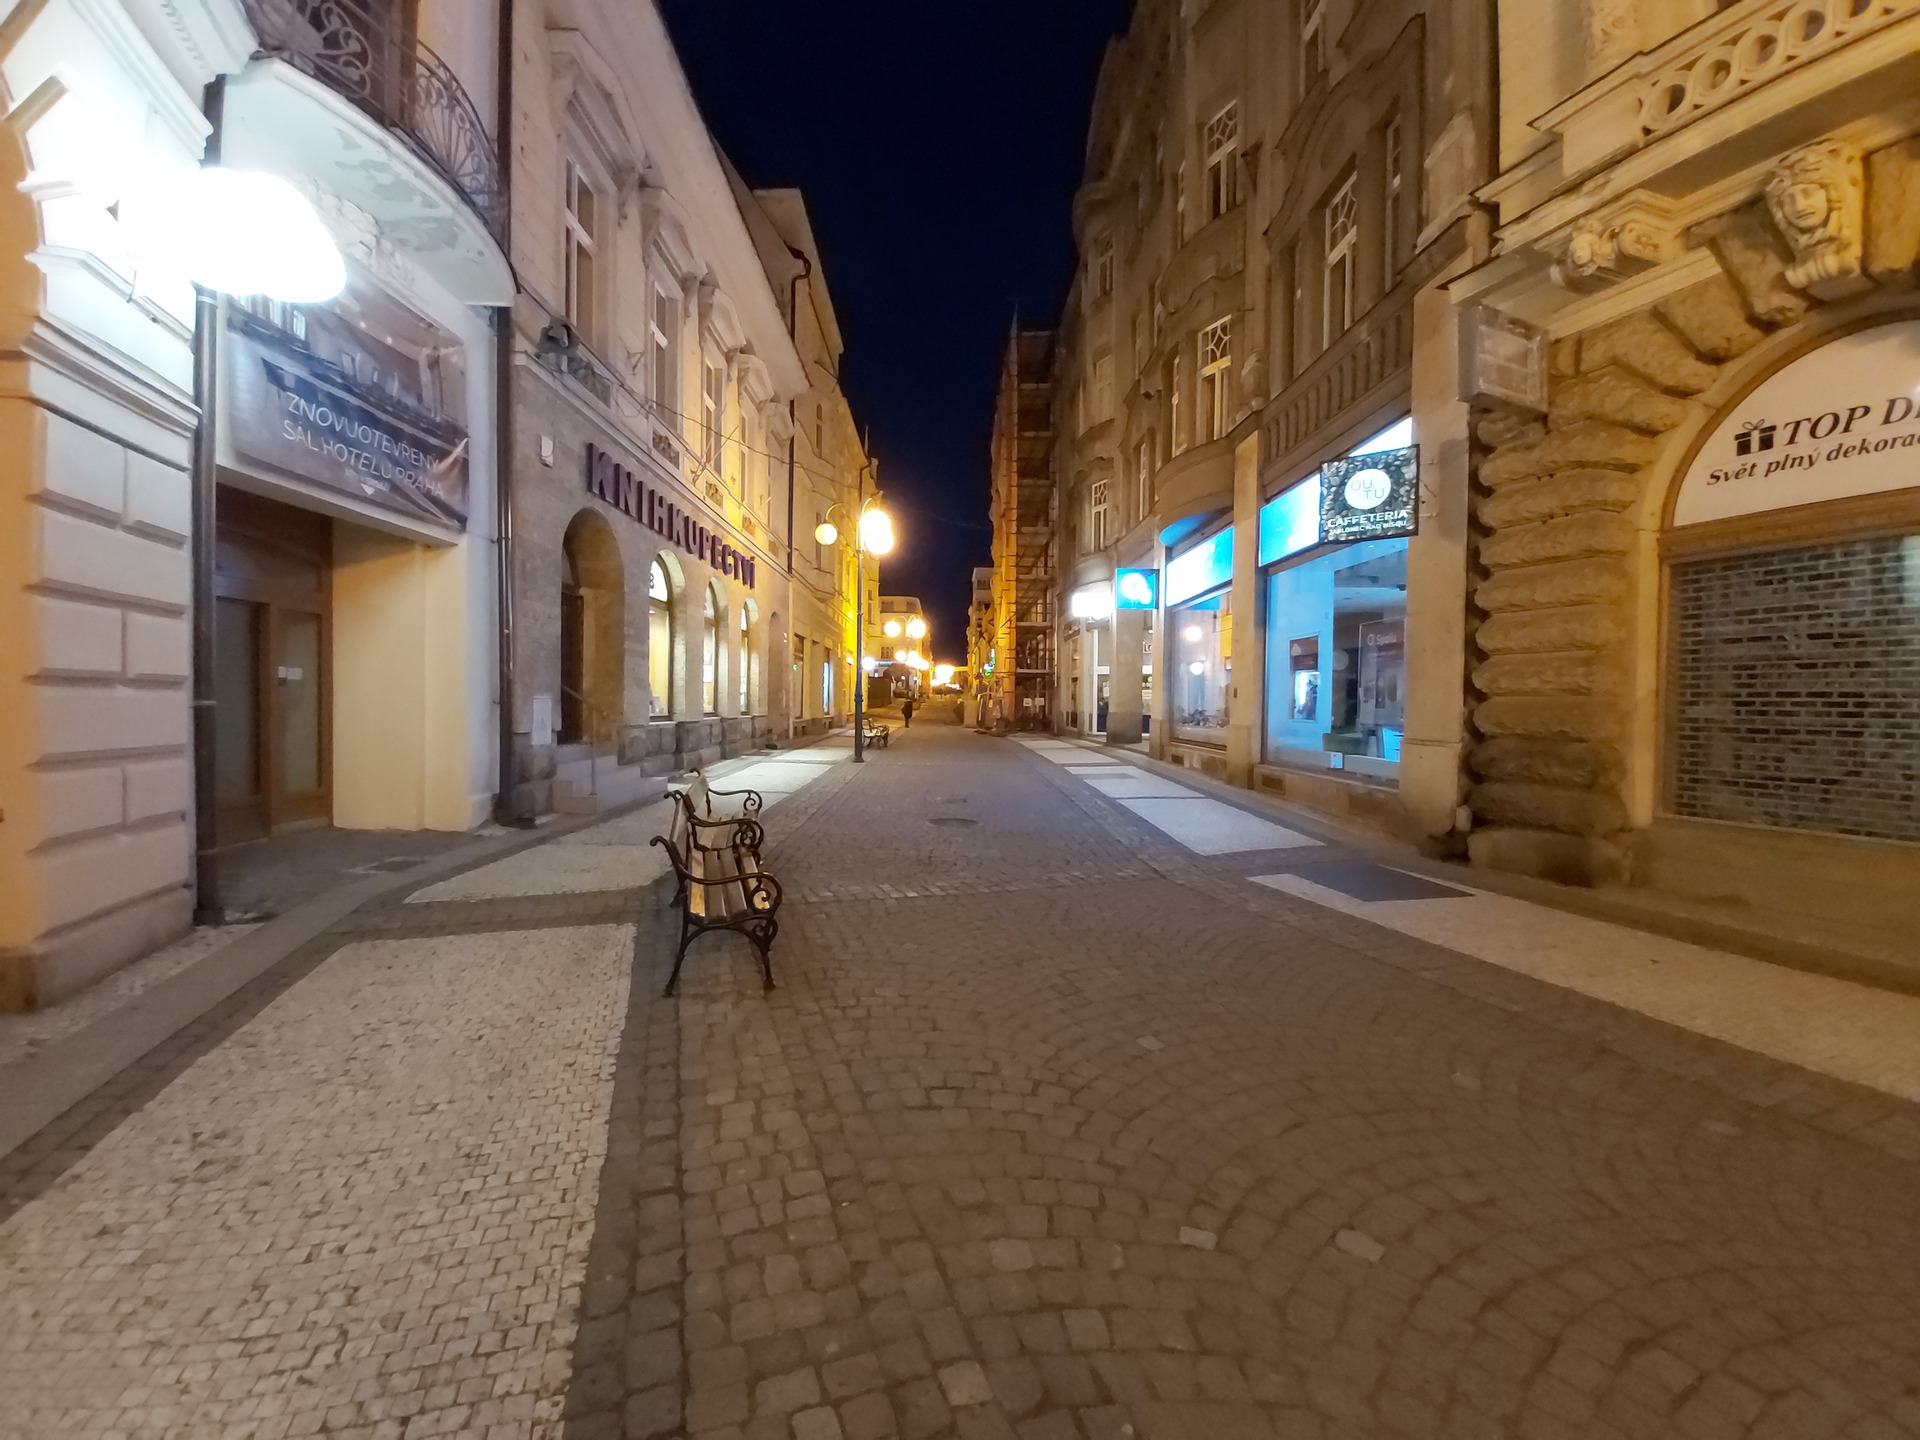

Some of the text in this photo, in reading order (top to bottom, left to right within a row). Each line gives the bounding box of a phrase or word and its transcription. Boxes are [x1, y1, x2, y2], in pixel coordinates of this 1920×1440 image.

[1783, 396, 1920, 446] TOP D
[282, 419, 319, 451] SÁL
[321, 437, 392, 479] HOTELU
[395, 467, 444, 499] PRAHA
[1706, 462, 1757, 486] Svět
[1764, 448, 1821, 478] plný
[1350, 479, 1373, 491] OU
[1362, 488, 1385, 500] TU
[586, 442, 756, 590] KNIHKUPECTVÍ
[1327, 509, 1408, 528] CAFFETERIA
